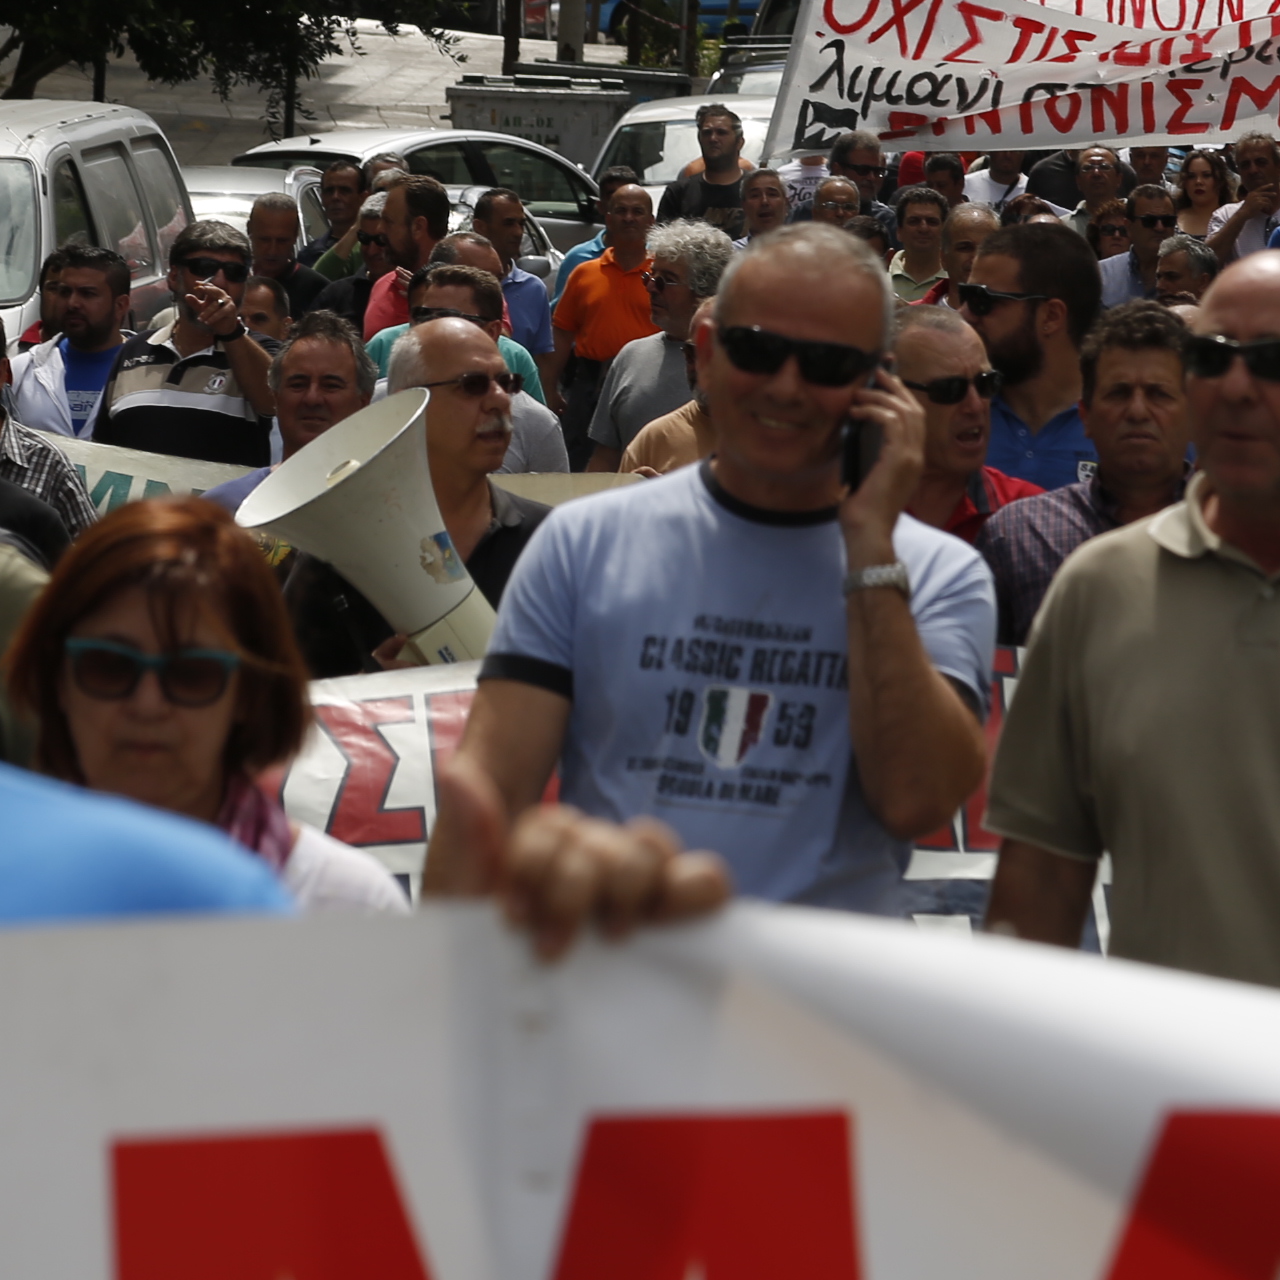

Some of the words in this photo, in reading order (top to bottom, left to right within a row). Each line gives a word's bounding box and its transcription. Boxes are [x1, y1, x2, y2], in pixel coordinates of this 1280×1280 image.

[808, 37, 1005, 121] λιμάνι
[638, 634, 744, 681] CLASSIC
[665, 687, 696, 736] 19
